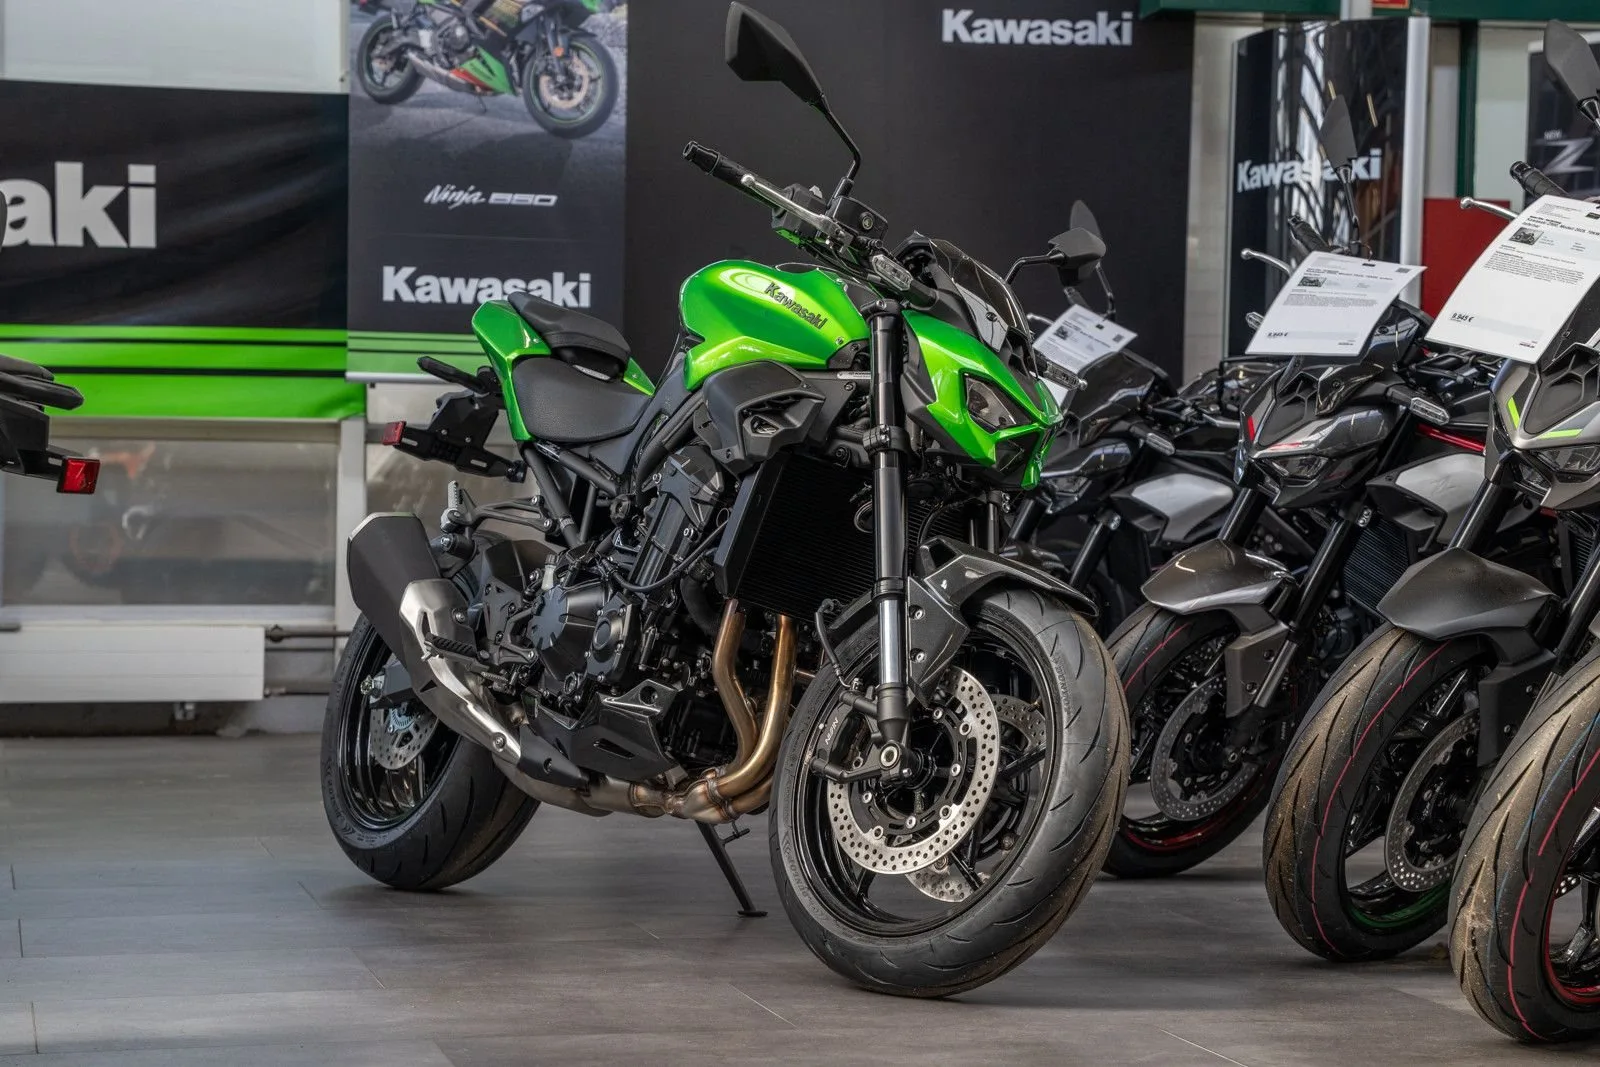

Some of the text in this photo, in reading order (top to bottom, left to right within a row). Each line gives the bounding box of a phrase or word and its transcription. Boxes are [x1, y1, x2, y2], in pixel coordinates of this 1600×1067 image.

[942, 8, 1133, 47] Kawasaki
[424, 184, 558, 210] Ninja 650
[382, 265, 591, 308] Kawasaki
[763, 282, 828, 330] Kawasaki
